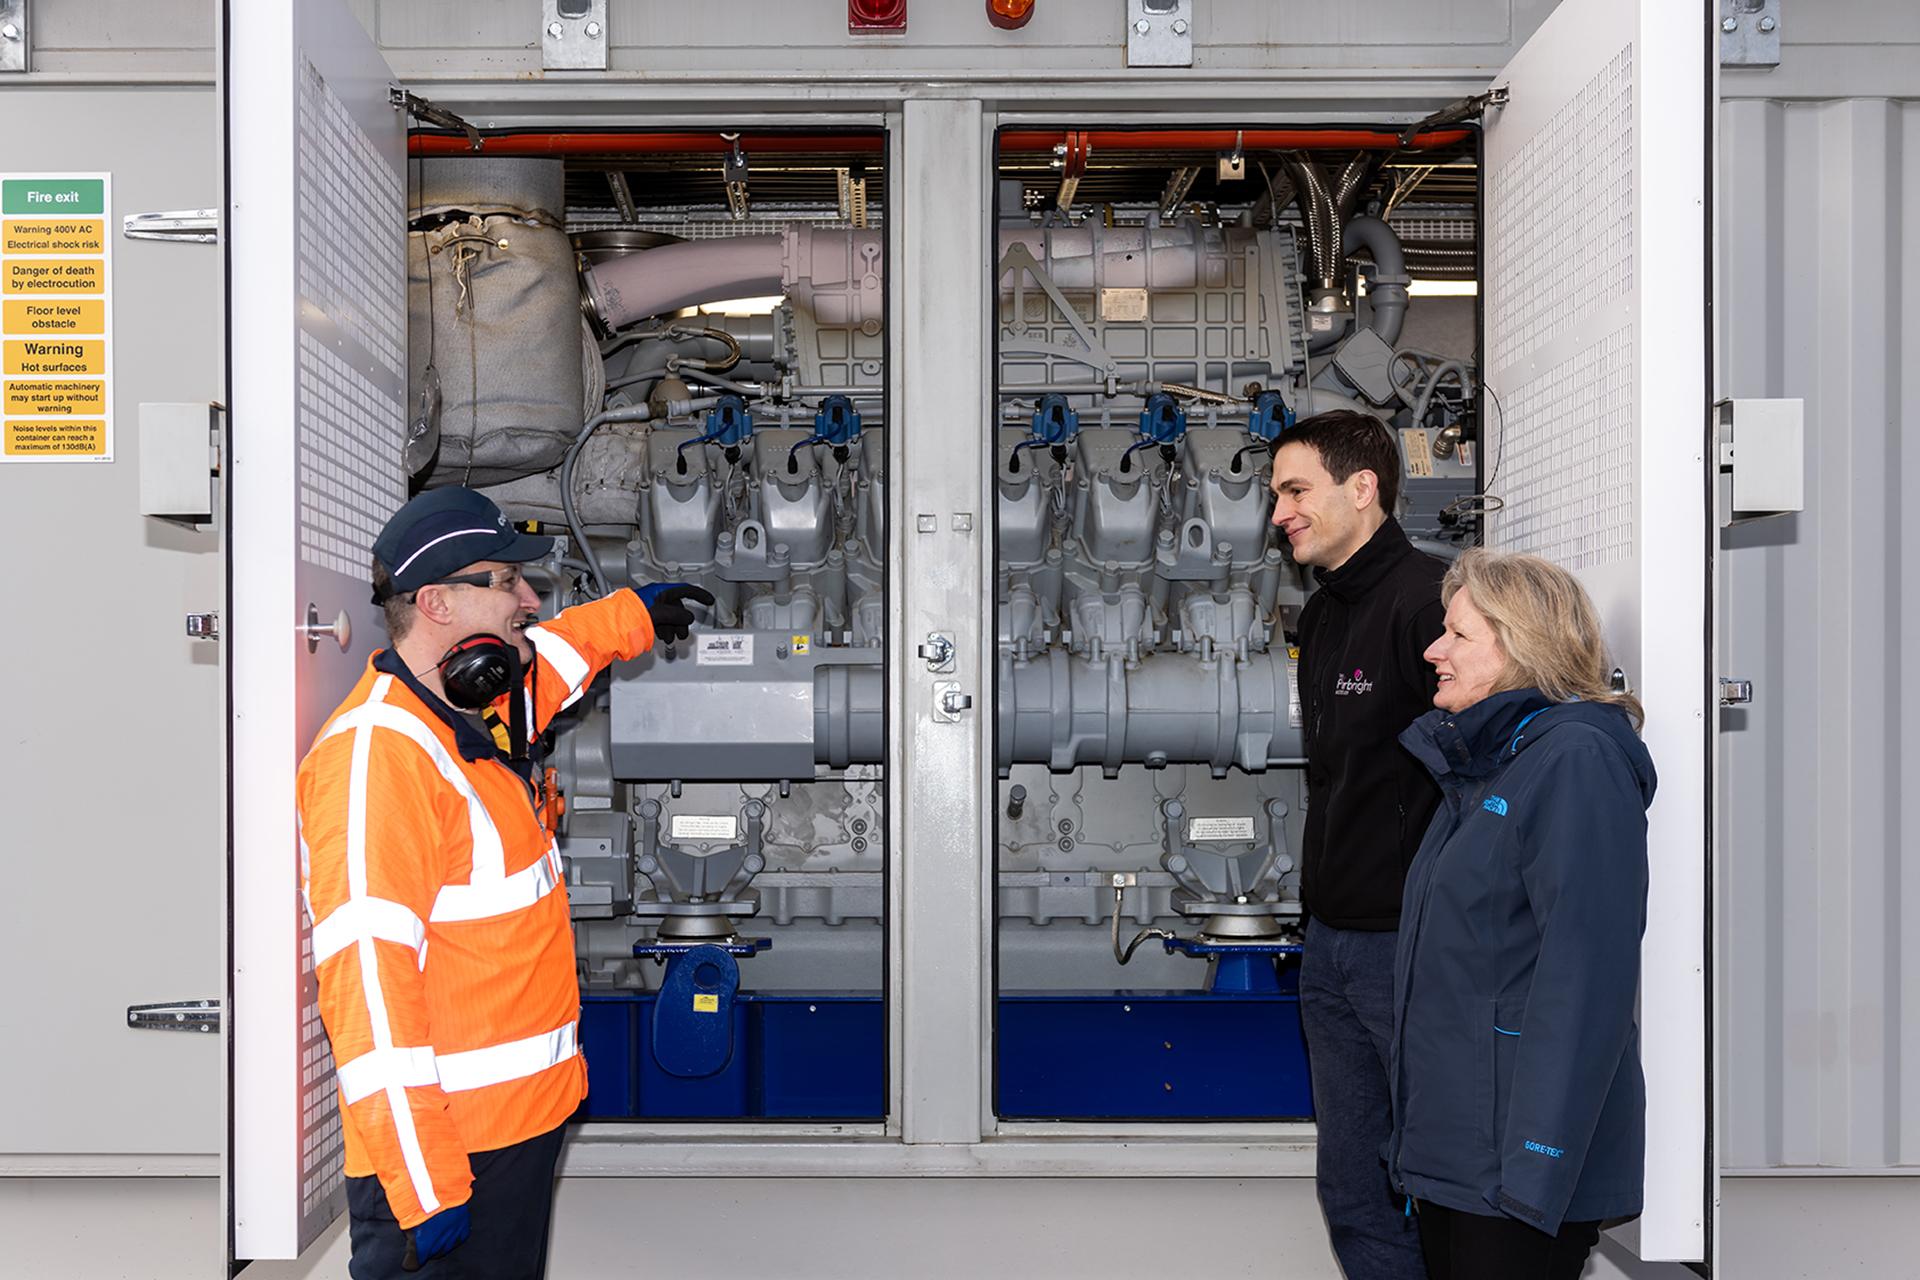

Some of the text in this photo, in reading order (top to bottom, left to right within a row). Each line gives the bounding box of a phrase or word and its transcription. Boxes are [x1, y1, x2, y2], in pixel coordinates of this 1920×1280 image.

[27, 191, 79, 203] Fire exit
[14, 225, 92, 235] Warning 400V AC
[8, 240, 100, 248] Electrical shock risk
[12, 266, 94, 278] Danger of death
[12, 279, 96, 290] by electrocution
[26, 306, 80, 316] Floor level
[32, 319, 76, 328] obstacle
[24, 343, 84, 358] Warning
[22, 363, 87, 372] Hot surfaces
[54, 384, 100, 393] machinery
[52, 396, 64, 404] up
[37, 404, 72, 414] warning
[62, 443, 96, 452] 130dB(A)
